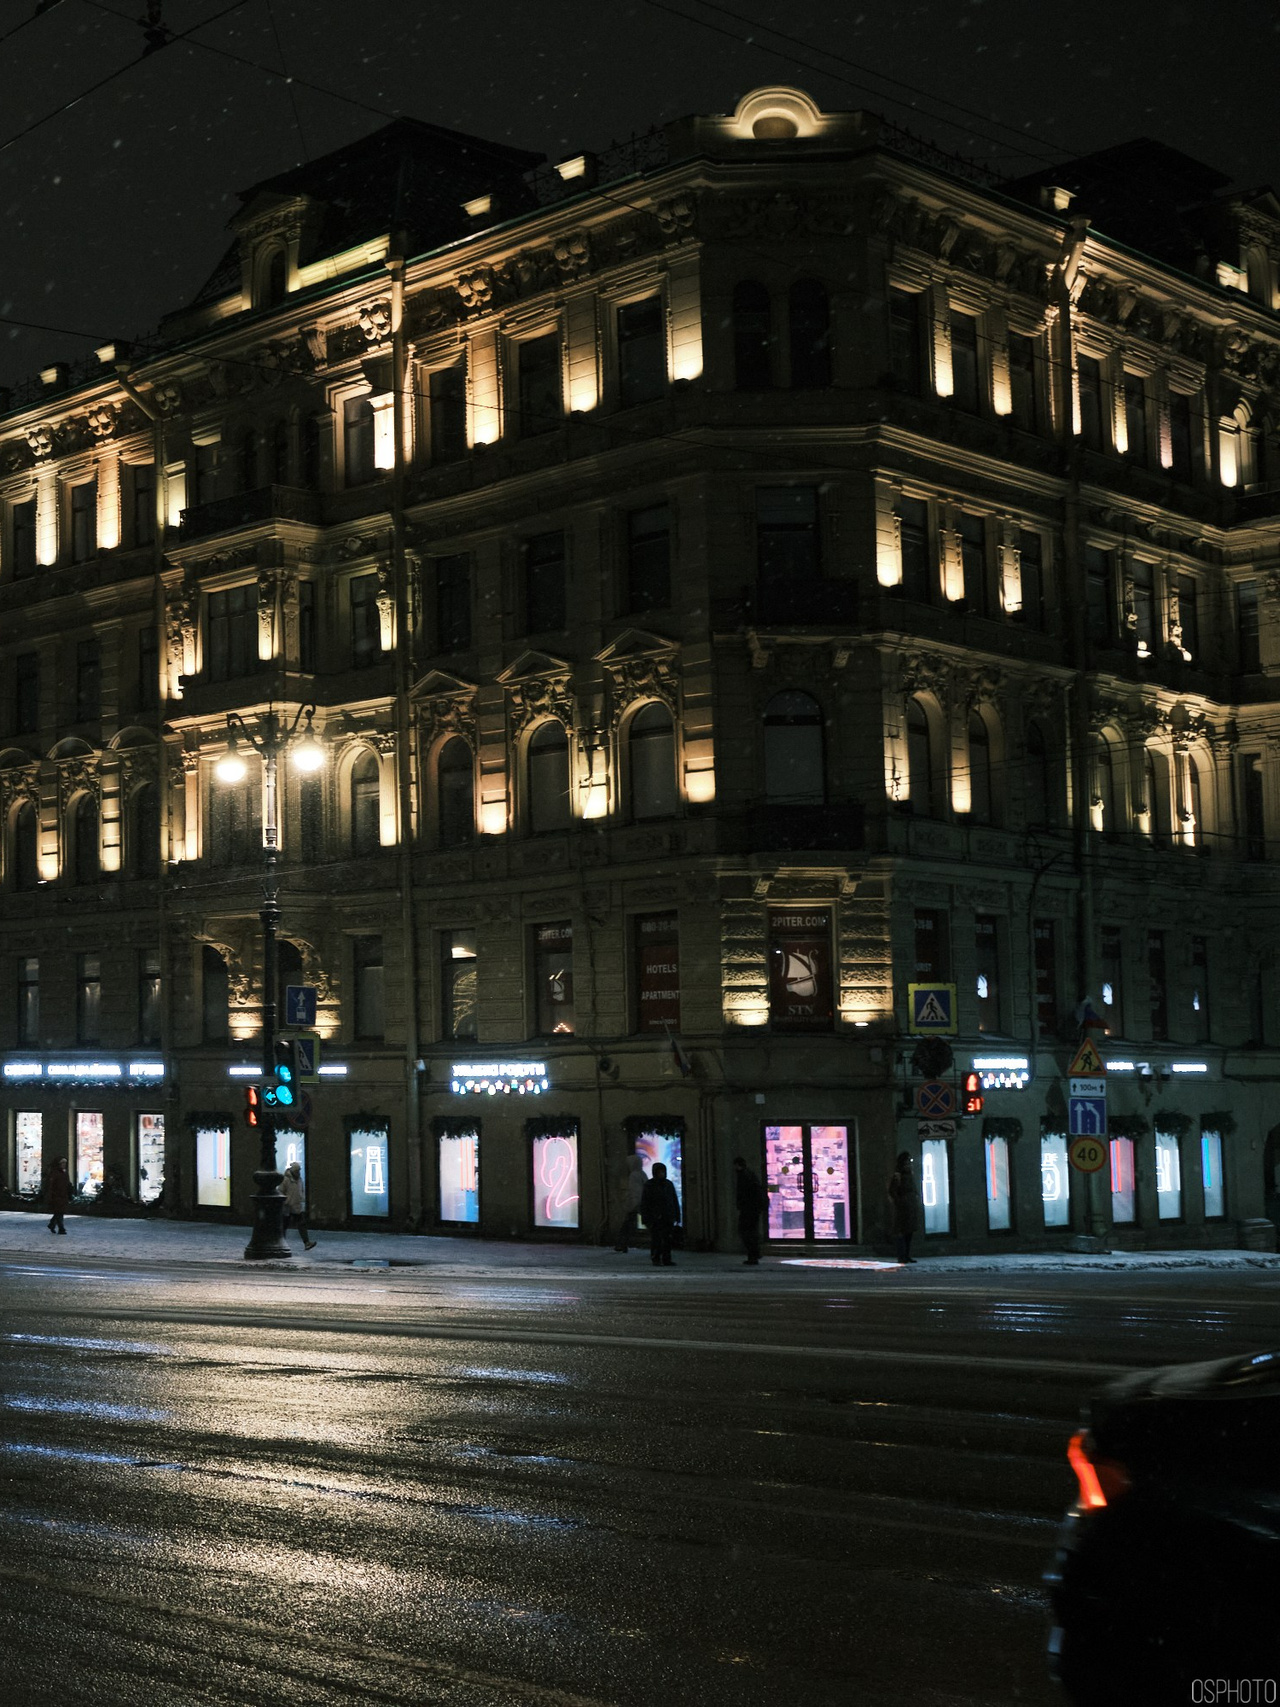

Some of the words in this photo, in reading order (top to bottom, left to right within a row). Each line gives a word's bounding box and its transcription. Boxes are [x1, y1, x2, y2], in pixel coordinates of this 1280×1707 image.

[646, 964, 678, 974] HOTELS
[788, 1005, 814, 1015] STN
[1077, 1147, 1098, 1161] 40
